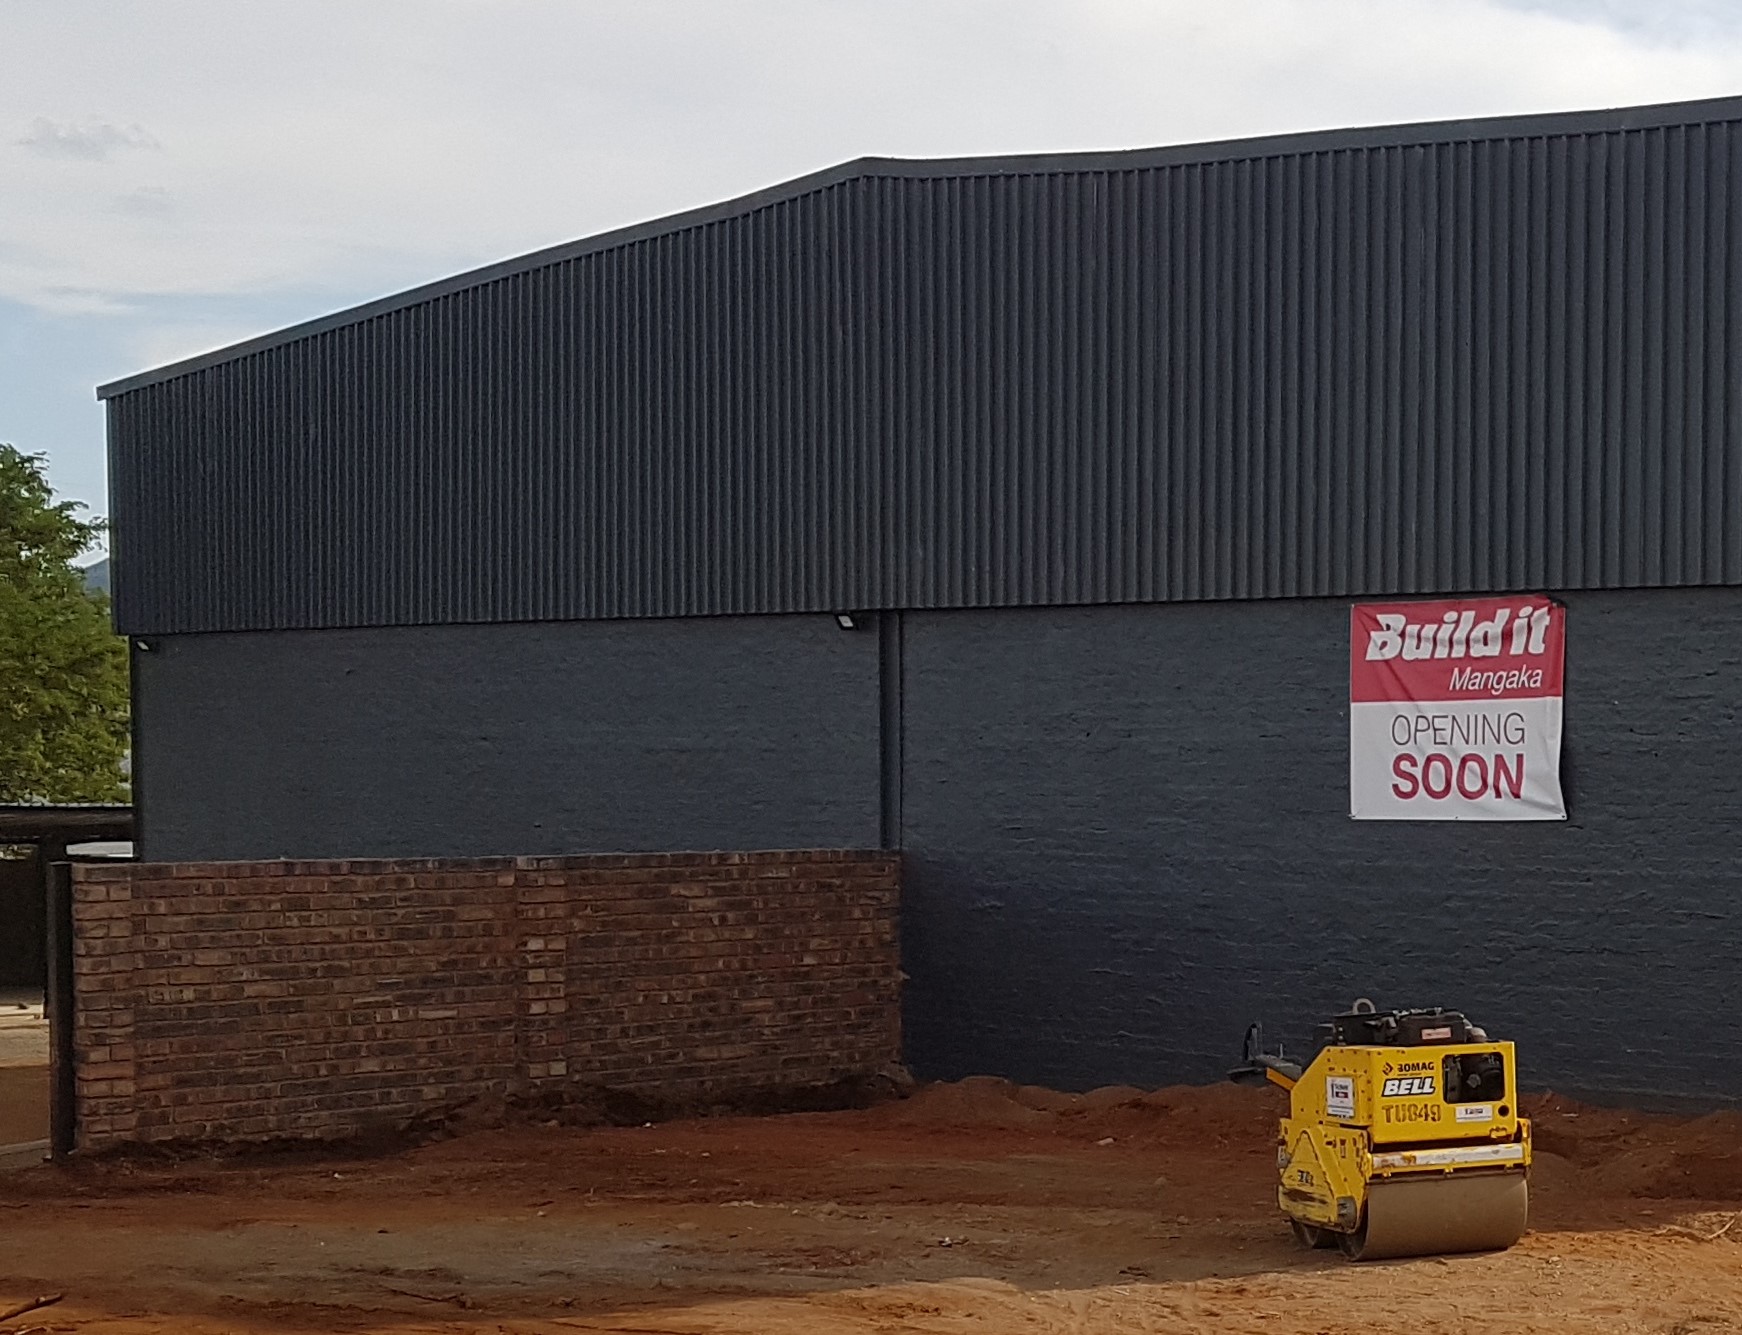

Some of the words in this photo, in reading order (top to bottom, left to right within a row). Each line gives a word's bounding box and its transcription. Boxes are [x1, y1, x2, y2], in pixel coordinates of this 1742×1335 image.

[1365, 608, 1511, 661] Build
[1509, 606, 1551, 656] it
[1449, 664, 1542, 695] Mangaka
[1391, 712, 1525, 745] OPENING
[1391, 753, 1524, 800] SOON
[1397, 1062, 1435, 1072] BOMAG
[1382, 1077, 1435, 1097] BELL
